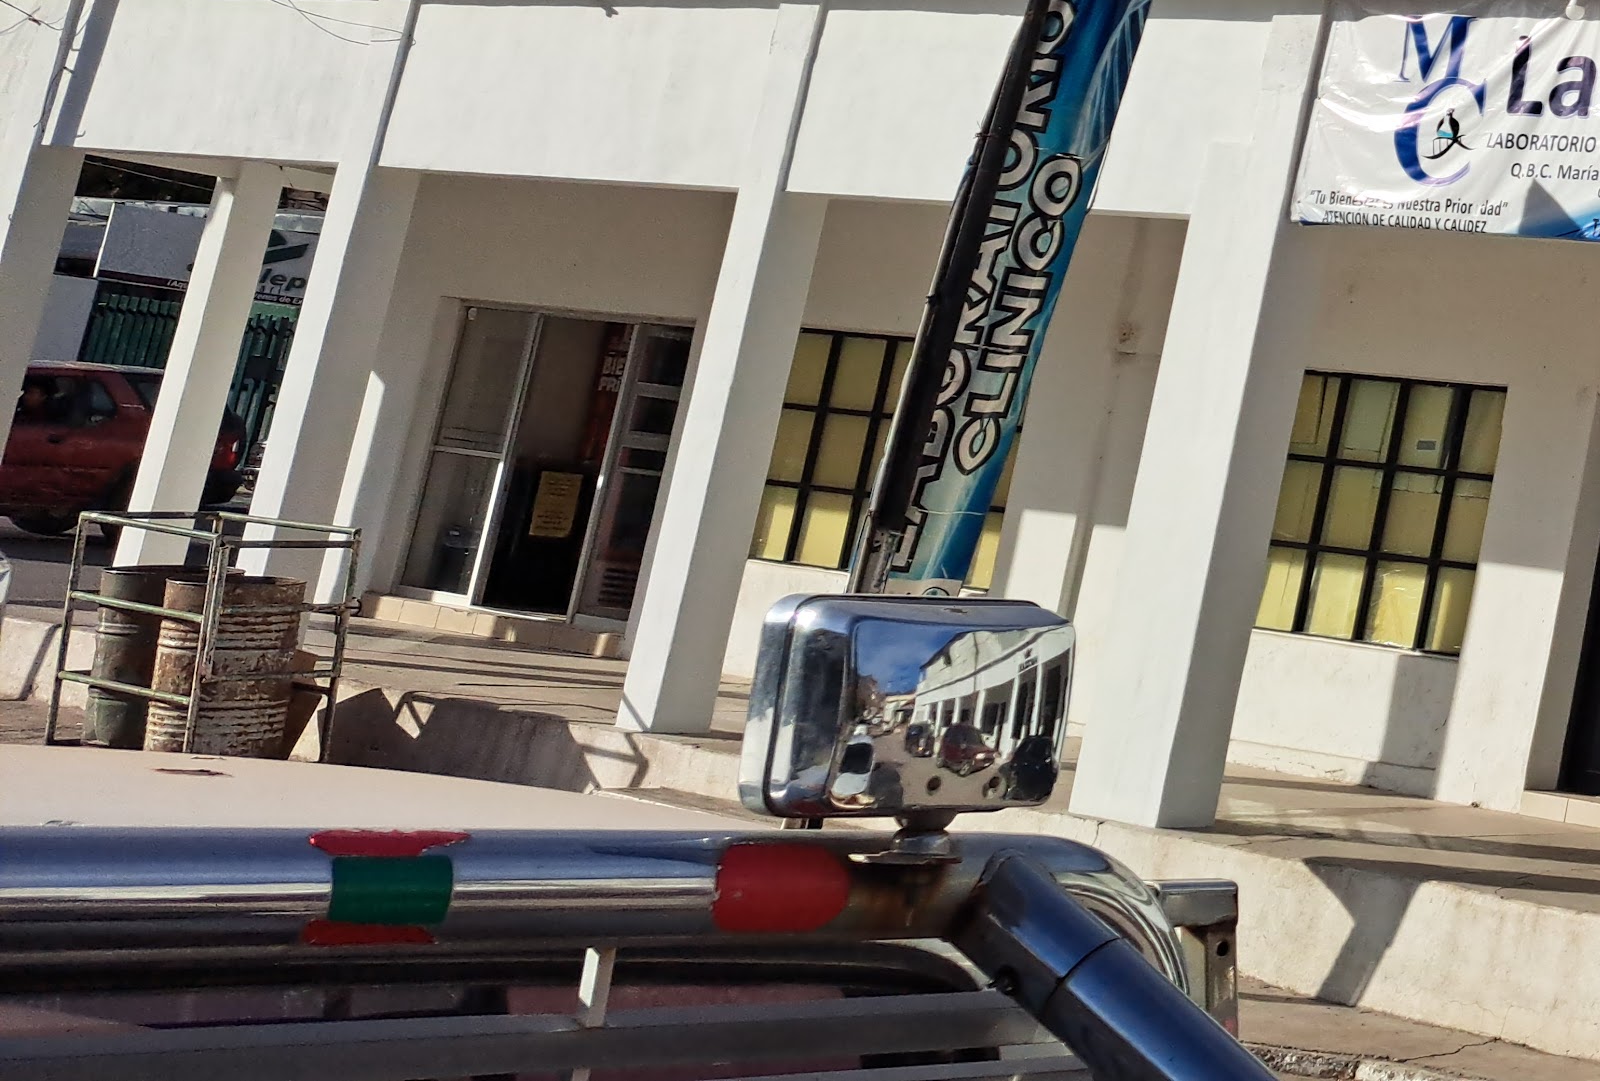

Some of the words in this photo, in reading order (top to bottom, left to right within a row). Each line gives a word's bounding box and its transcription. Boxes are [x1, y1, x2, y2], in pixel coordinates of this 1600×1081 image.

[1486, 131, 1597, 154] LABORATORIO
[1510, 162, 1552, 180] Q.B.C.
[1557, 164, 1599, 182] María
[1372, 213, 1386, 227] DE
[1388, 214, 1432, 230] CALIDAD
[1435, 217, 1442, 229] Y
[1444, 219, 1488, 233] CALIDEZ
